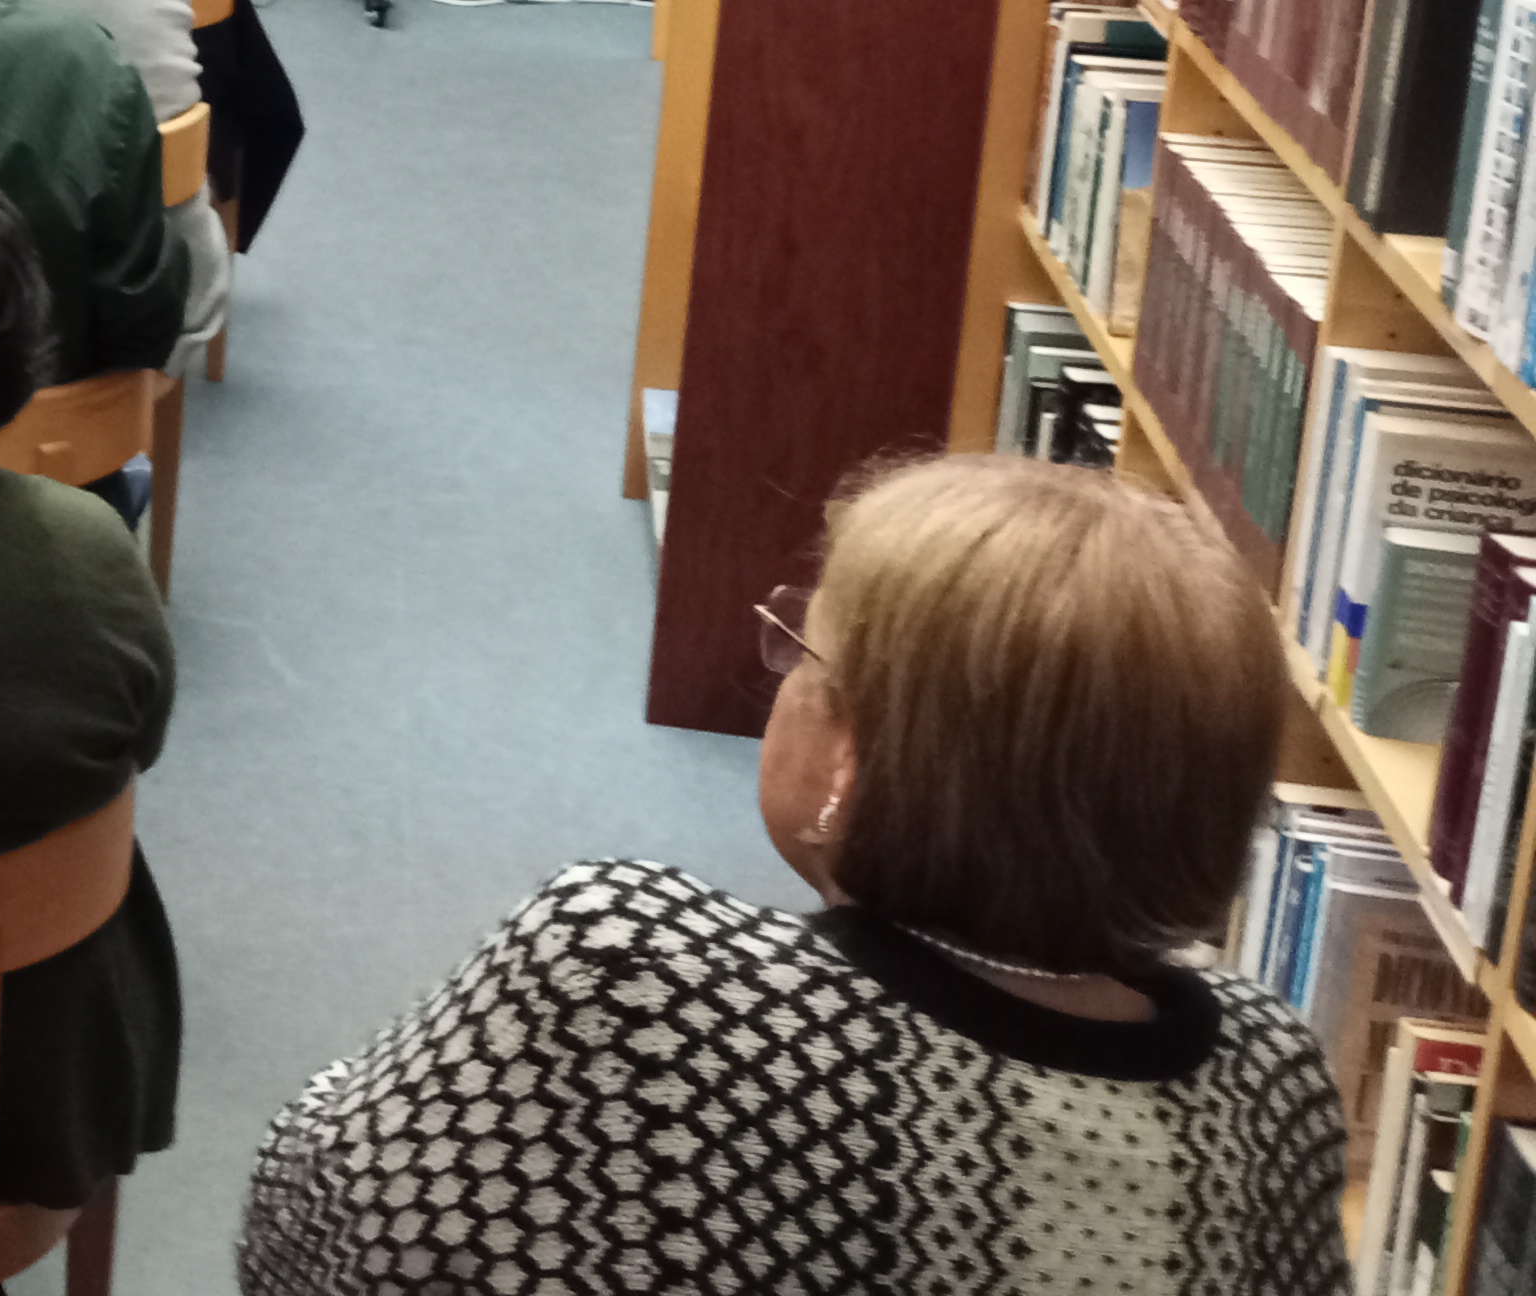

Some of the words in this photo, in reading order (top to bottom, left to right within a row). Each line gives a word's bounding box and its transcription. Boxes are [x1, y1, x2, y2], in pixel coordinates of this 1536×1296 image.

[1393, 460, 1522, 491] dicionário
[1391, 480, 1422, 499] de
[1388, 500, 1418, 517] da
